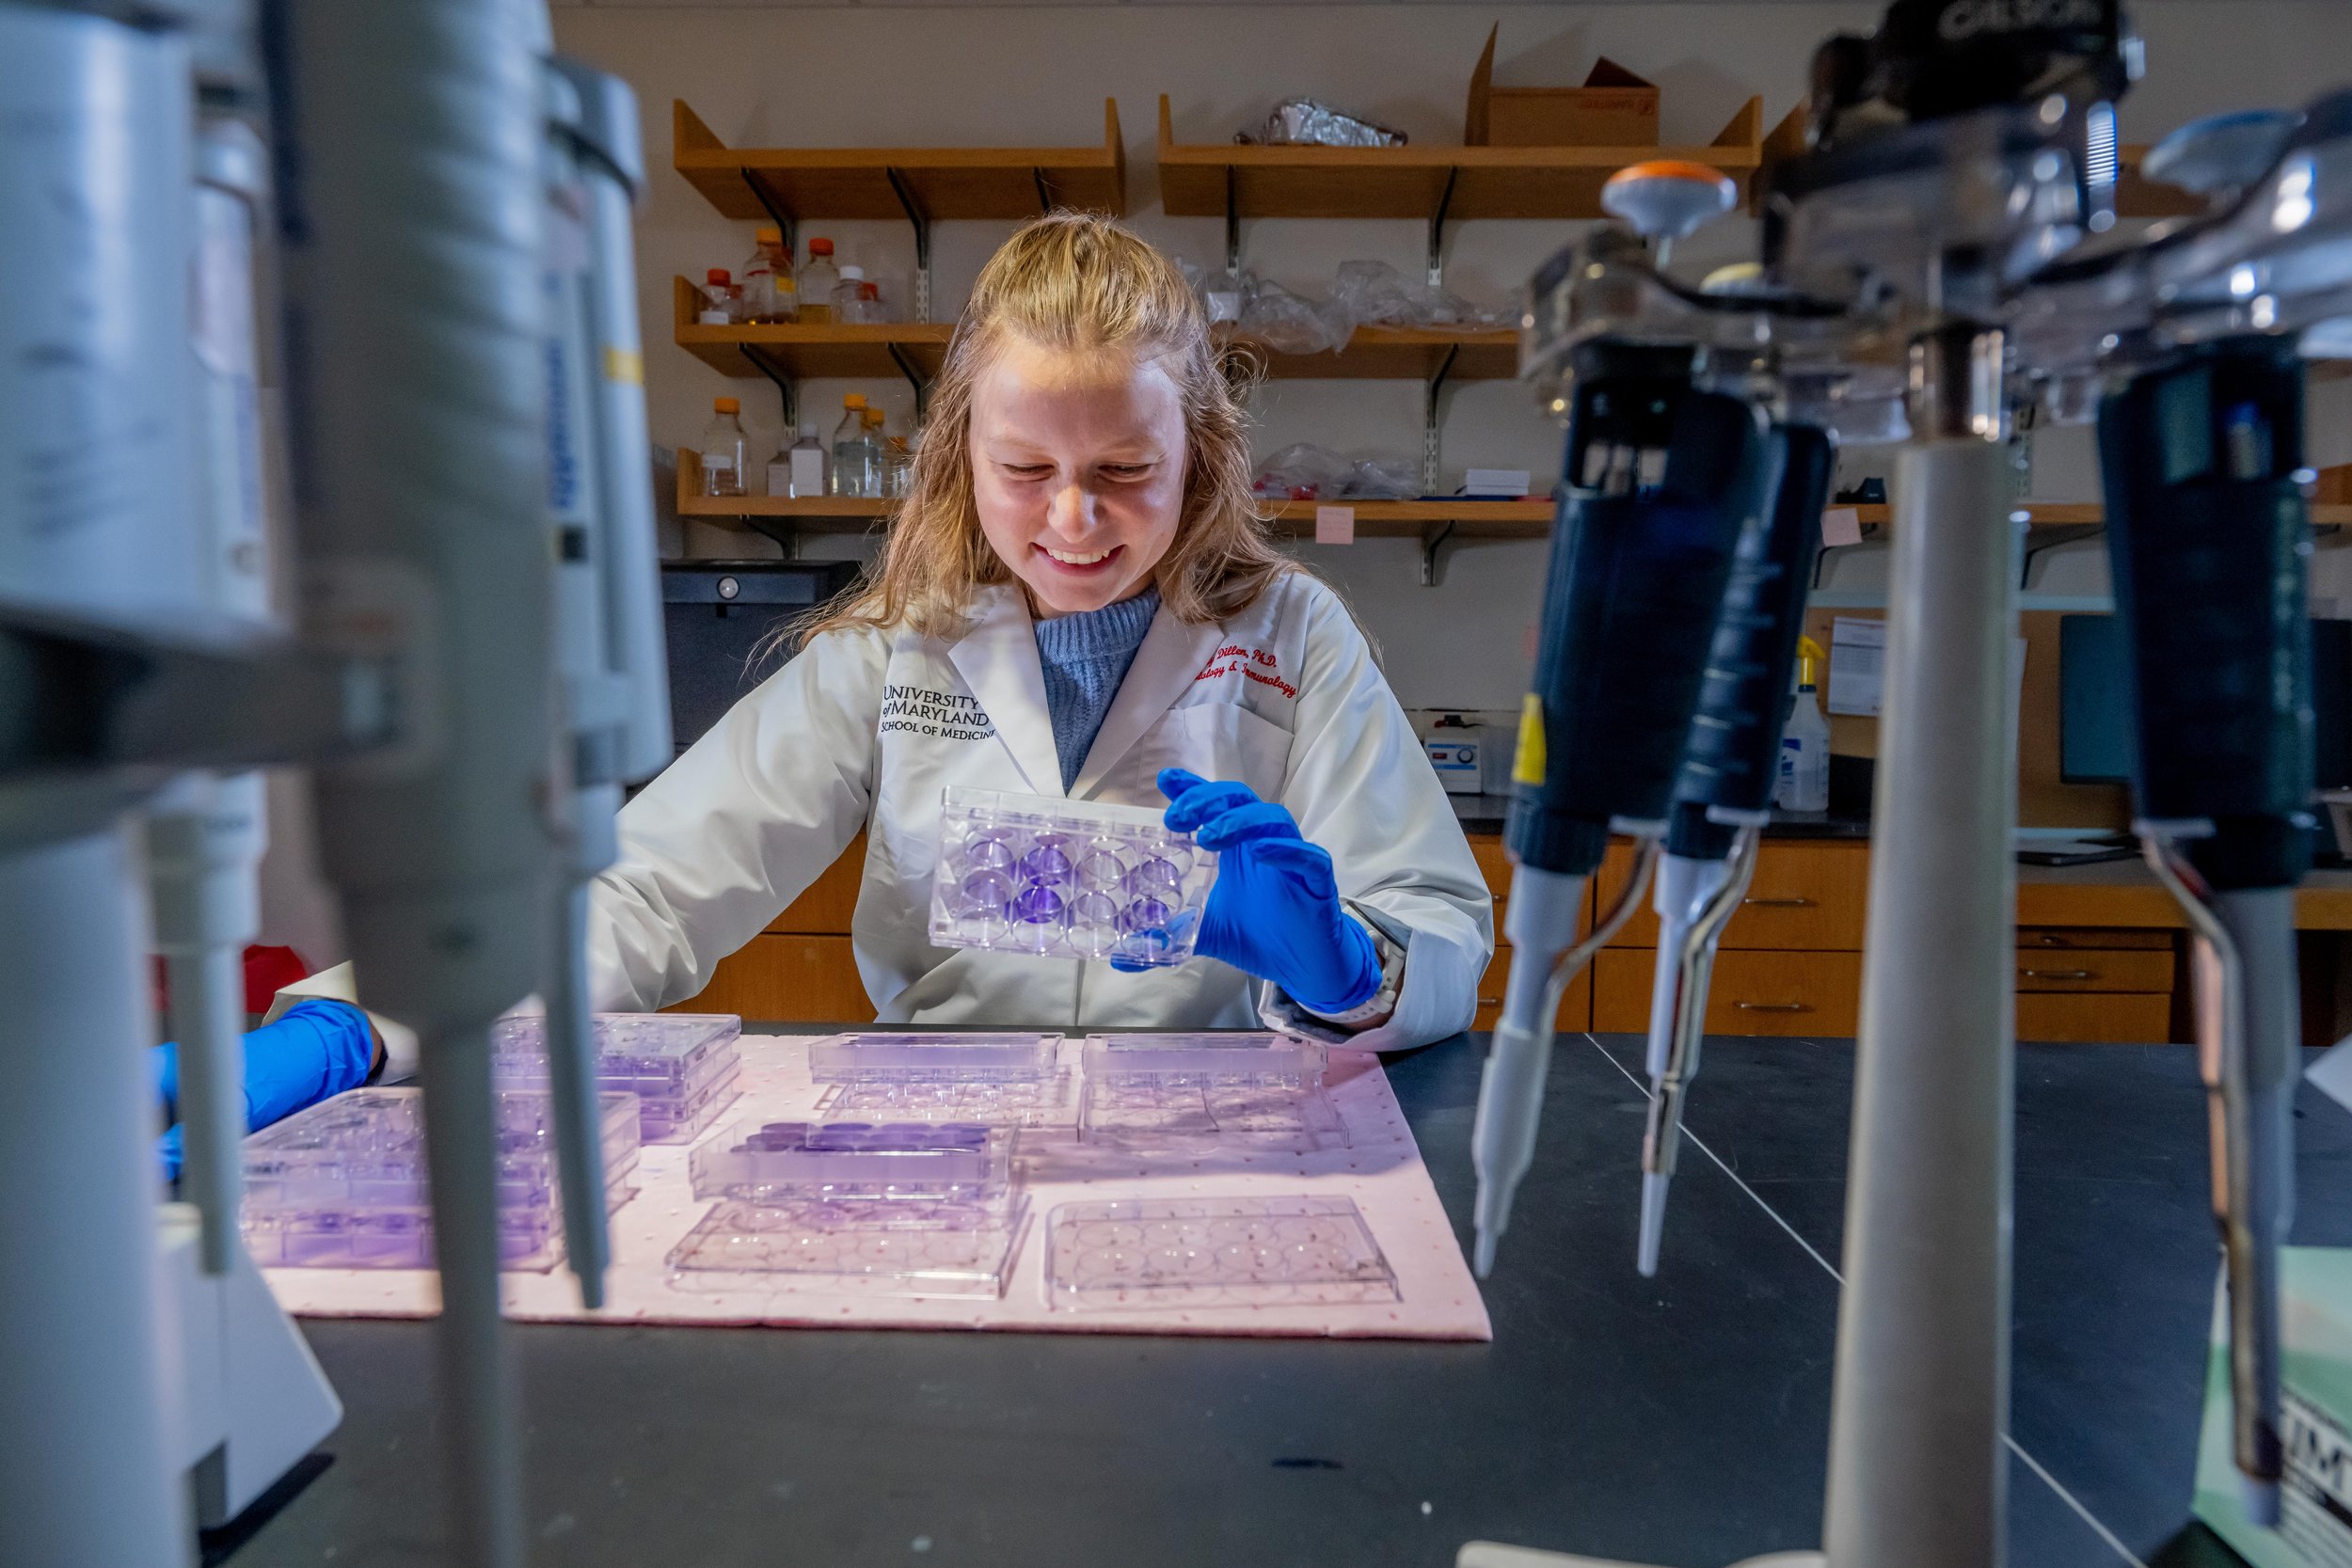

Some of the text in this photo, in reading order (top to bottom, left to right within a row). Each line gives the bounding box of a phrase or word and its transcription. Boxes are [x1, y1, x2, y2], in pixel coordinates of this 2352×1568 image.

[1229, 660, 1237, 672] &
[1241, 663, 1296, 699] Immunology
[883, 685, 979, 710] UNIVERSITY
[882, 700, 990, 727] of MARYLAND
[881, 721, 919, 733] SCHOOL
[921, 725, 938, 736] OF
